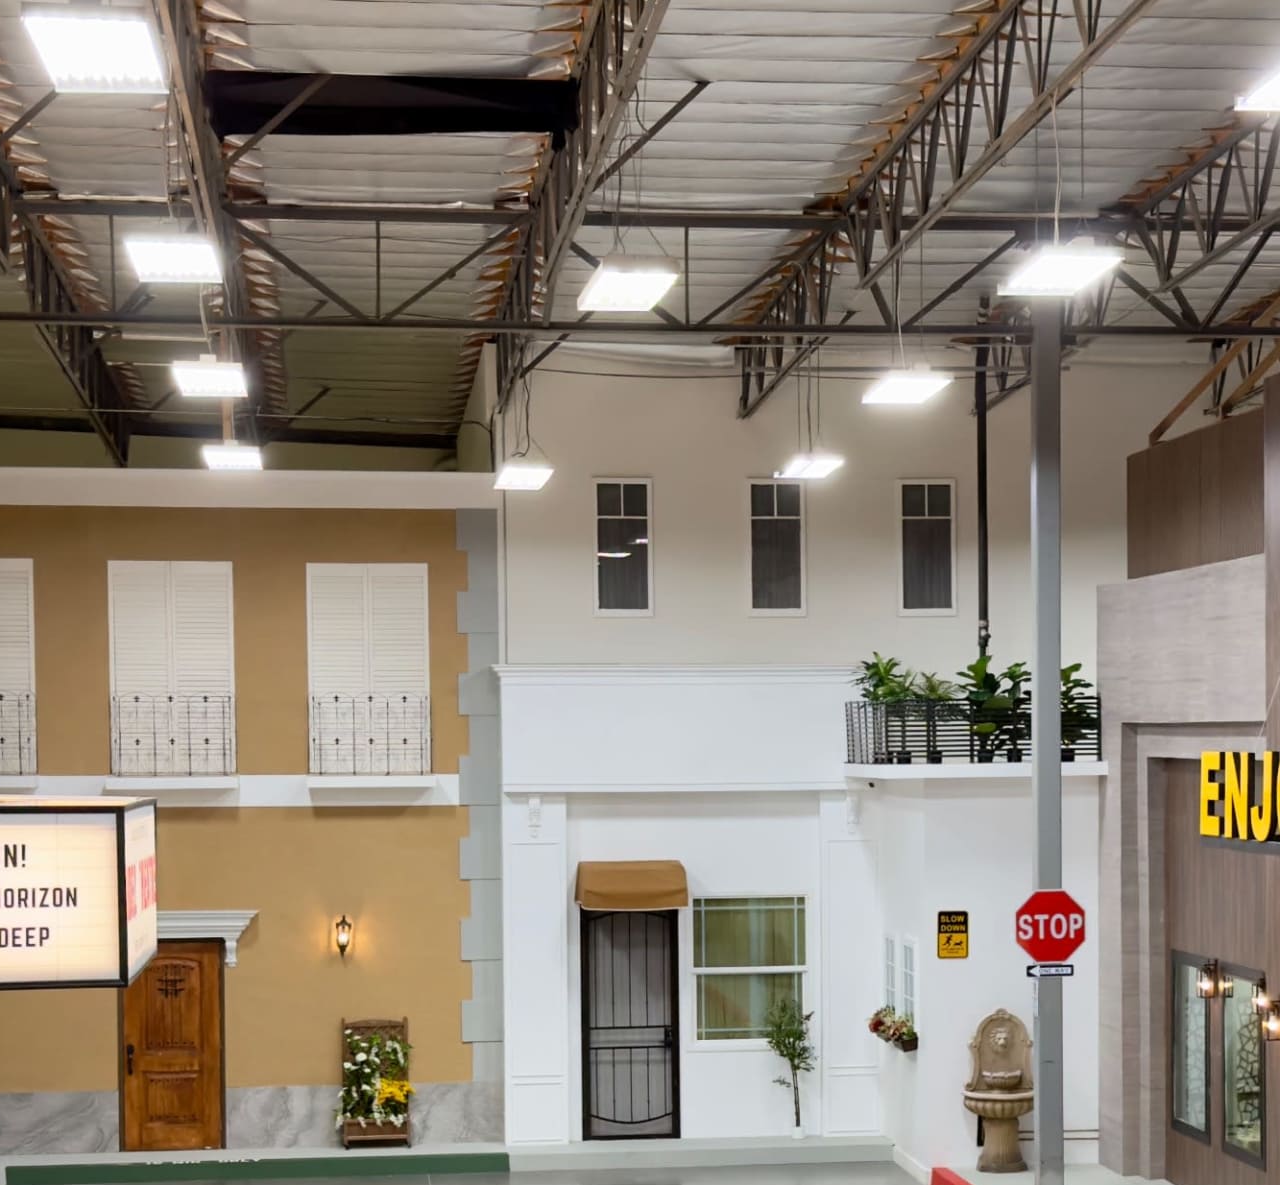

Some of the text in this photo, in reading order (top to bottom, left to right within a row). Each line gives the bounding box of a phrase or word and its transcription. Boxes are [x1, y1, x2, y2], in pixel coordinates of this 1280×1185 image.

[940, 914, 965, 923] SLOW
[940, 924, 966, 932] DOWN
[1018, 912, 1083, 940] STOP
